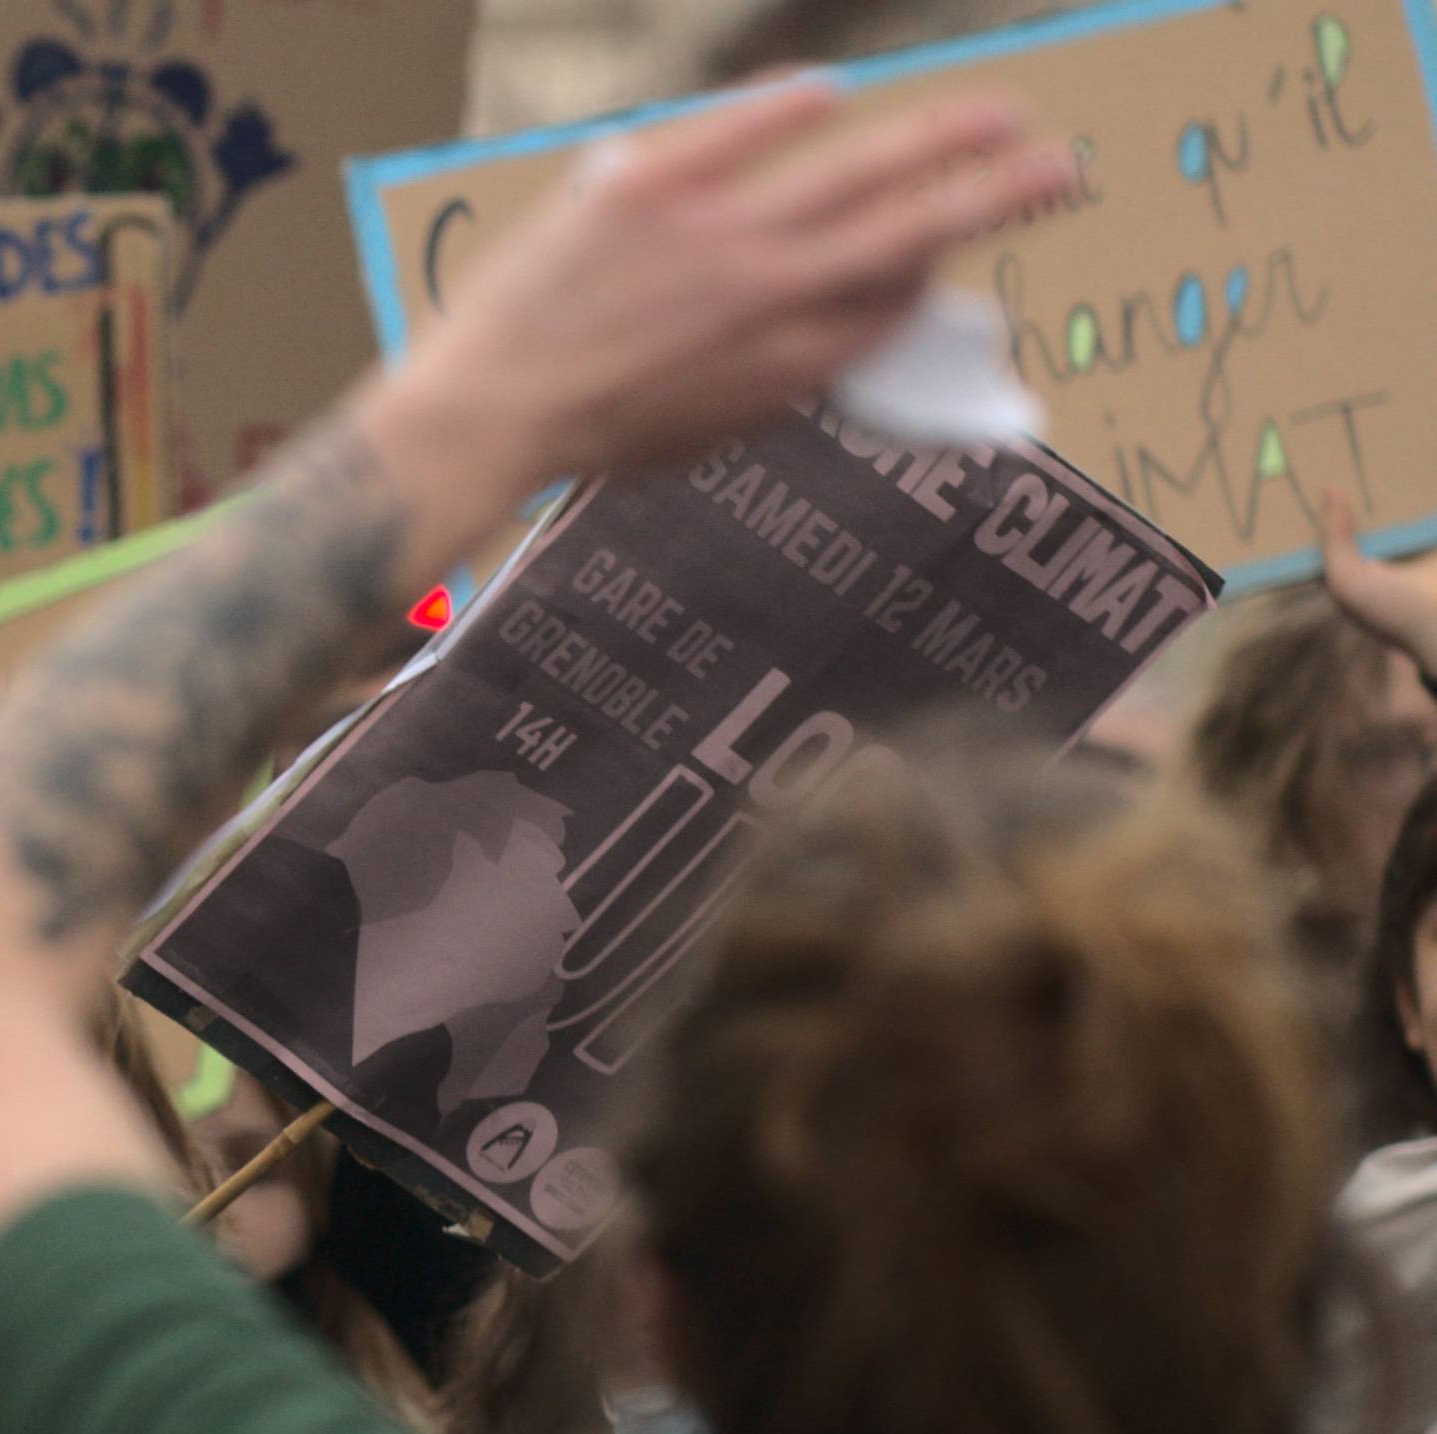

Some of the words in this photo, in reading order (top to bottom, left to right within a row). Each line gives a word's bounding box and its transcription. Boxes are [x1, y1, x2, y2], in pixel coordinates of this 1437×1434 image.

[993, 246, 1329, 430] hanger
[1104, 388, 1392, 546] iMAT
[571, 548, 686, 645] GARE
[665, 618, 735, 681] DE
[687, 437, 879, 597] SAMEDI
[863, 562, 935, 635] 12
[911, 598, 1048, 715] MARS
[974, 472, 1207, 656] CLIMAT
[494, 700, 578, 772] 14H
[497, 601, 691, 752] GRENOBLE
[691, 666, 907, 808] LO
